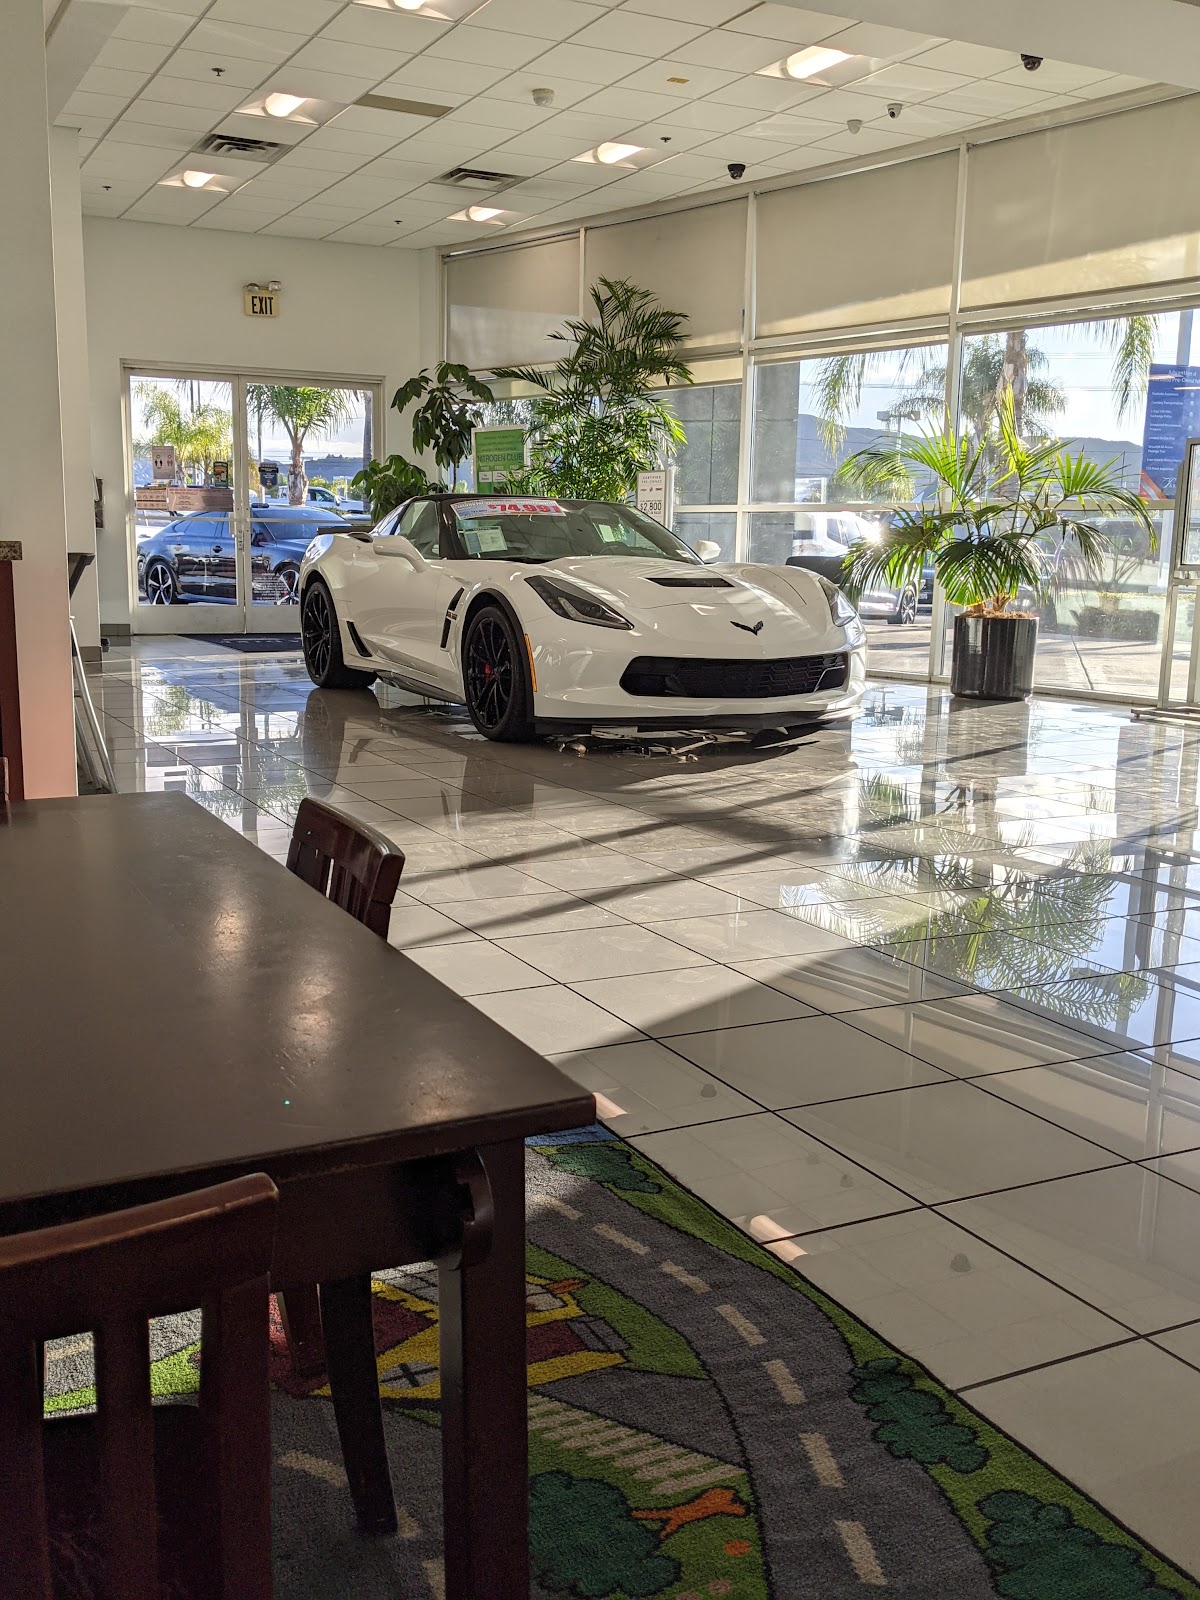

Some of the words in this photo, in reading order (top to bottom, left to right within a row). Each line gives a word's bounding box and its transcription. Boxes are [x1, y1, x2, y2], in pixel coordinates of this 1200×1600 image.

[252, 296, 273, 315] EXIT
[478, 453, 506, 462] NITROGEN
[506, 453, 523, 462] CLUB
